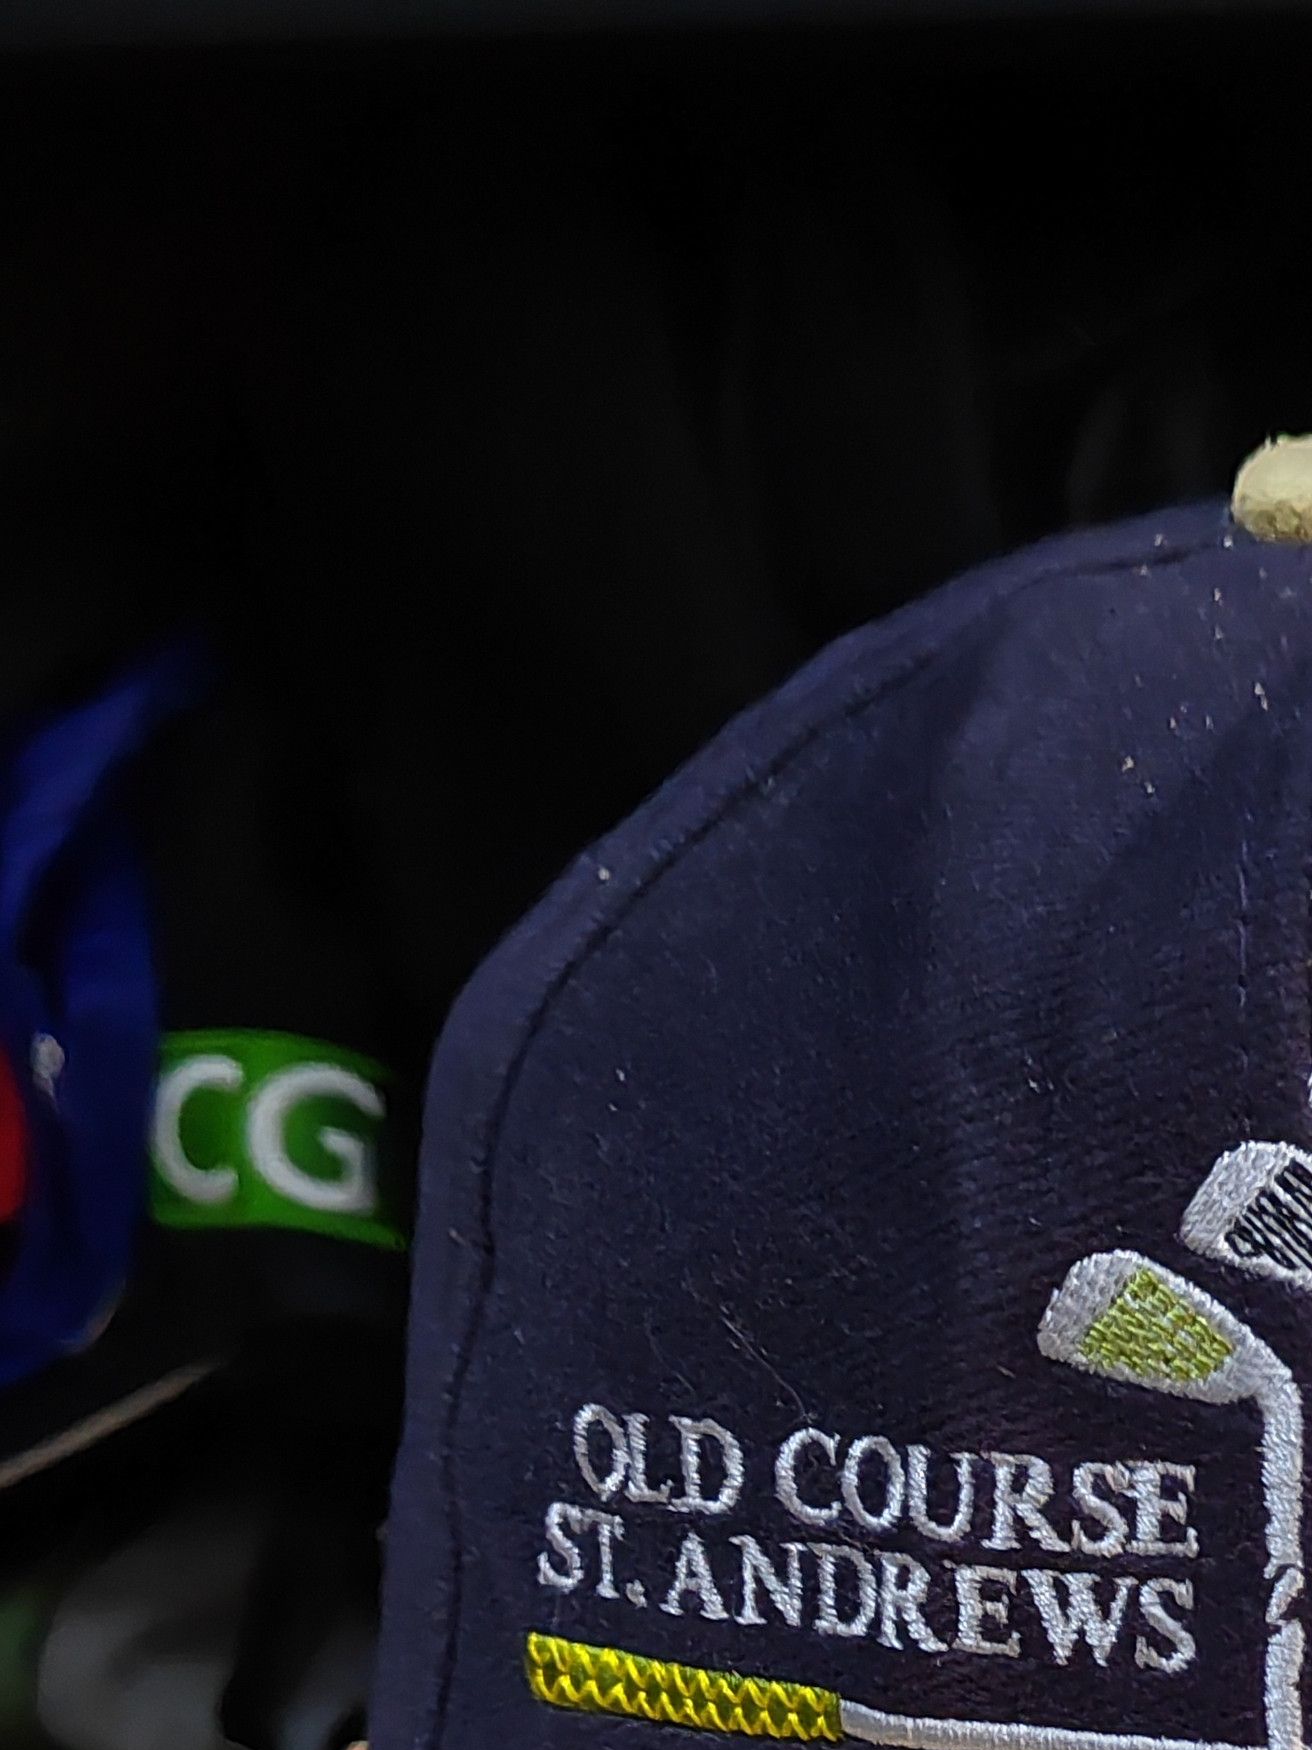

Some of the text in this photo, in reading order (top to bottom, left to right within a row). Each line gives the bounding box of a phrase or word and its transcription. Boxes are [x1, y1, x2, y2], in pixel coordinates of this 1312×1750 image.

[152, 1053, 387, 1217] CG
[573, 1402, 1199, 1558] OLD COURSE
